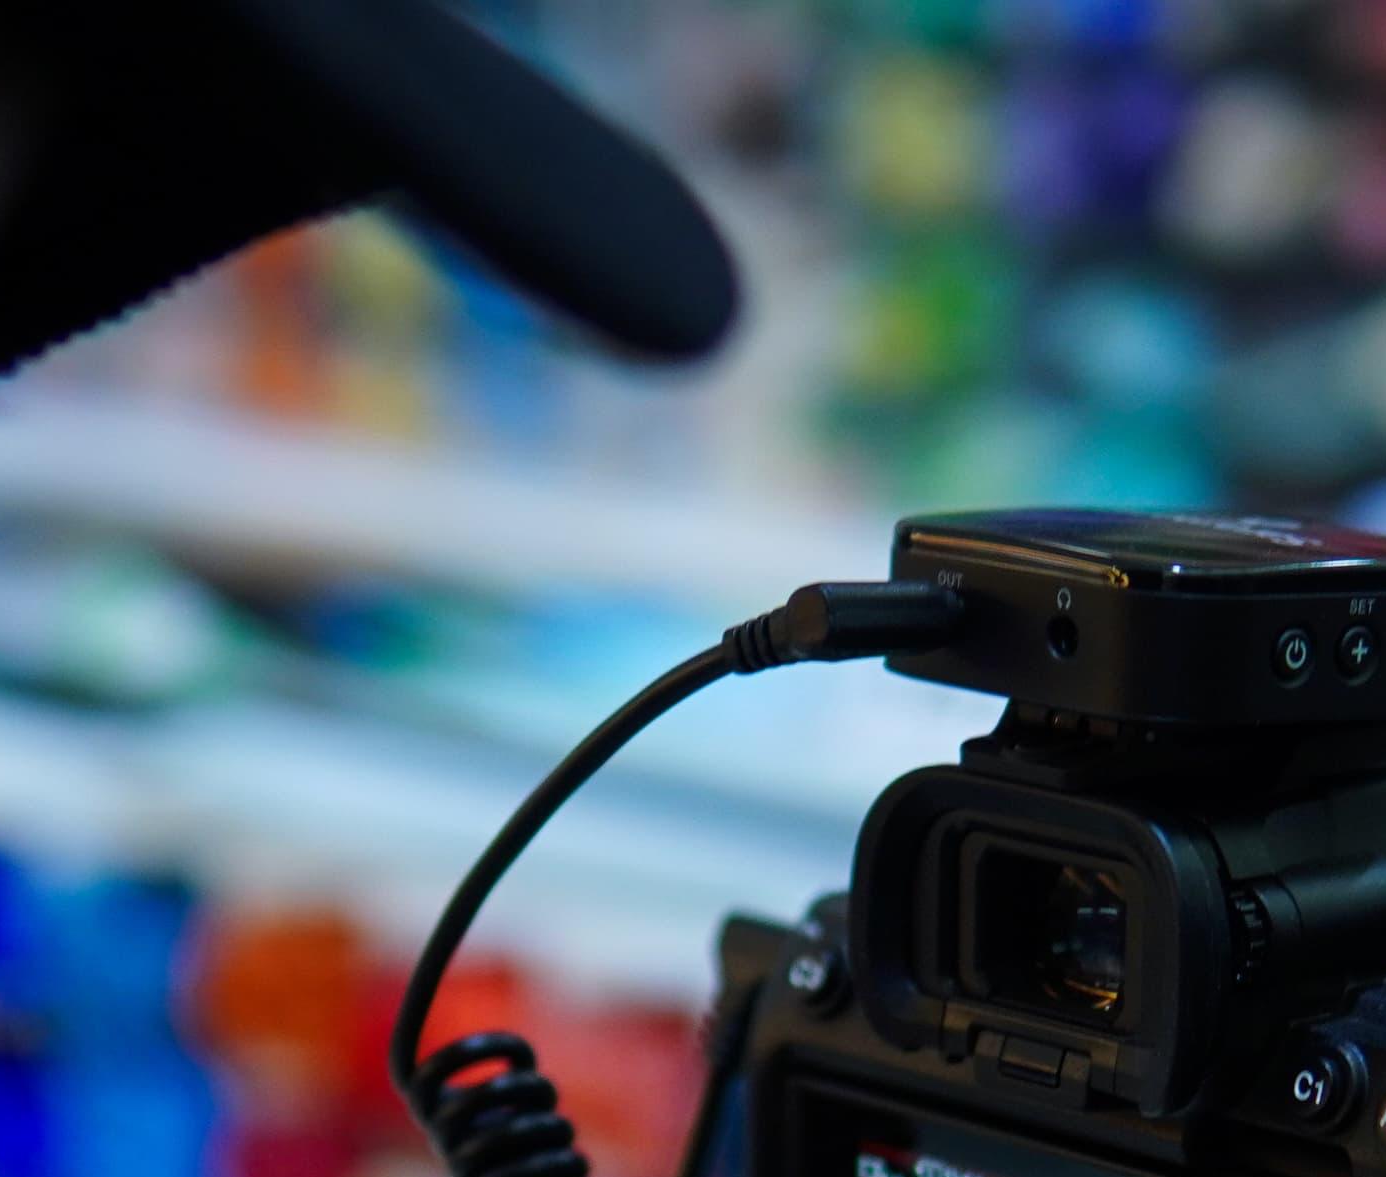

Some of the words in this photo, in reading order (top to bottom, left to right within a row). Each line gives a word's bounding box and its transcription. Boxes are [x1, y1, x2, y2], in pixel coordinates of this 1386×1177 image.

[937, 571, 963, 589] OUT
[1349, 597, 1376, 616] SET
[1294, 1071, 1324, 1105] C1
